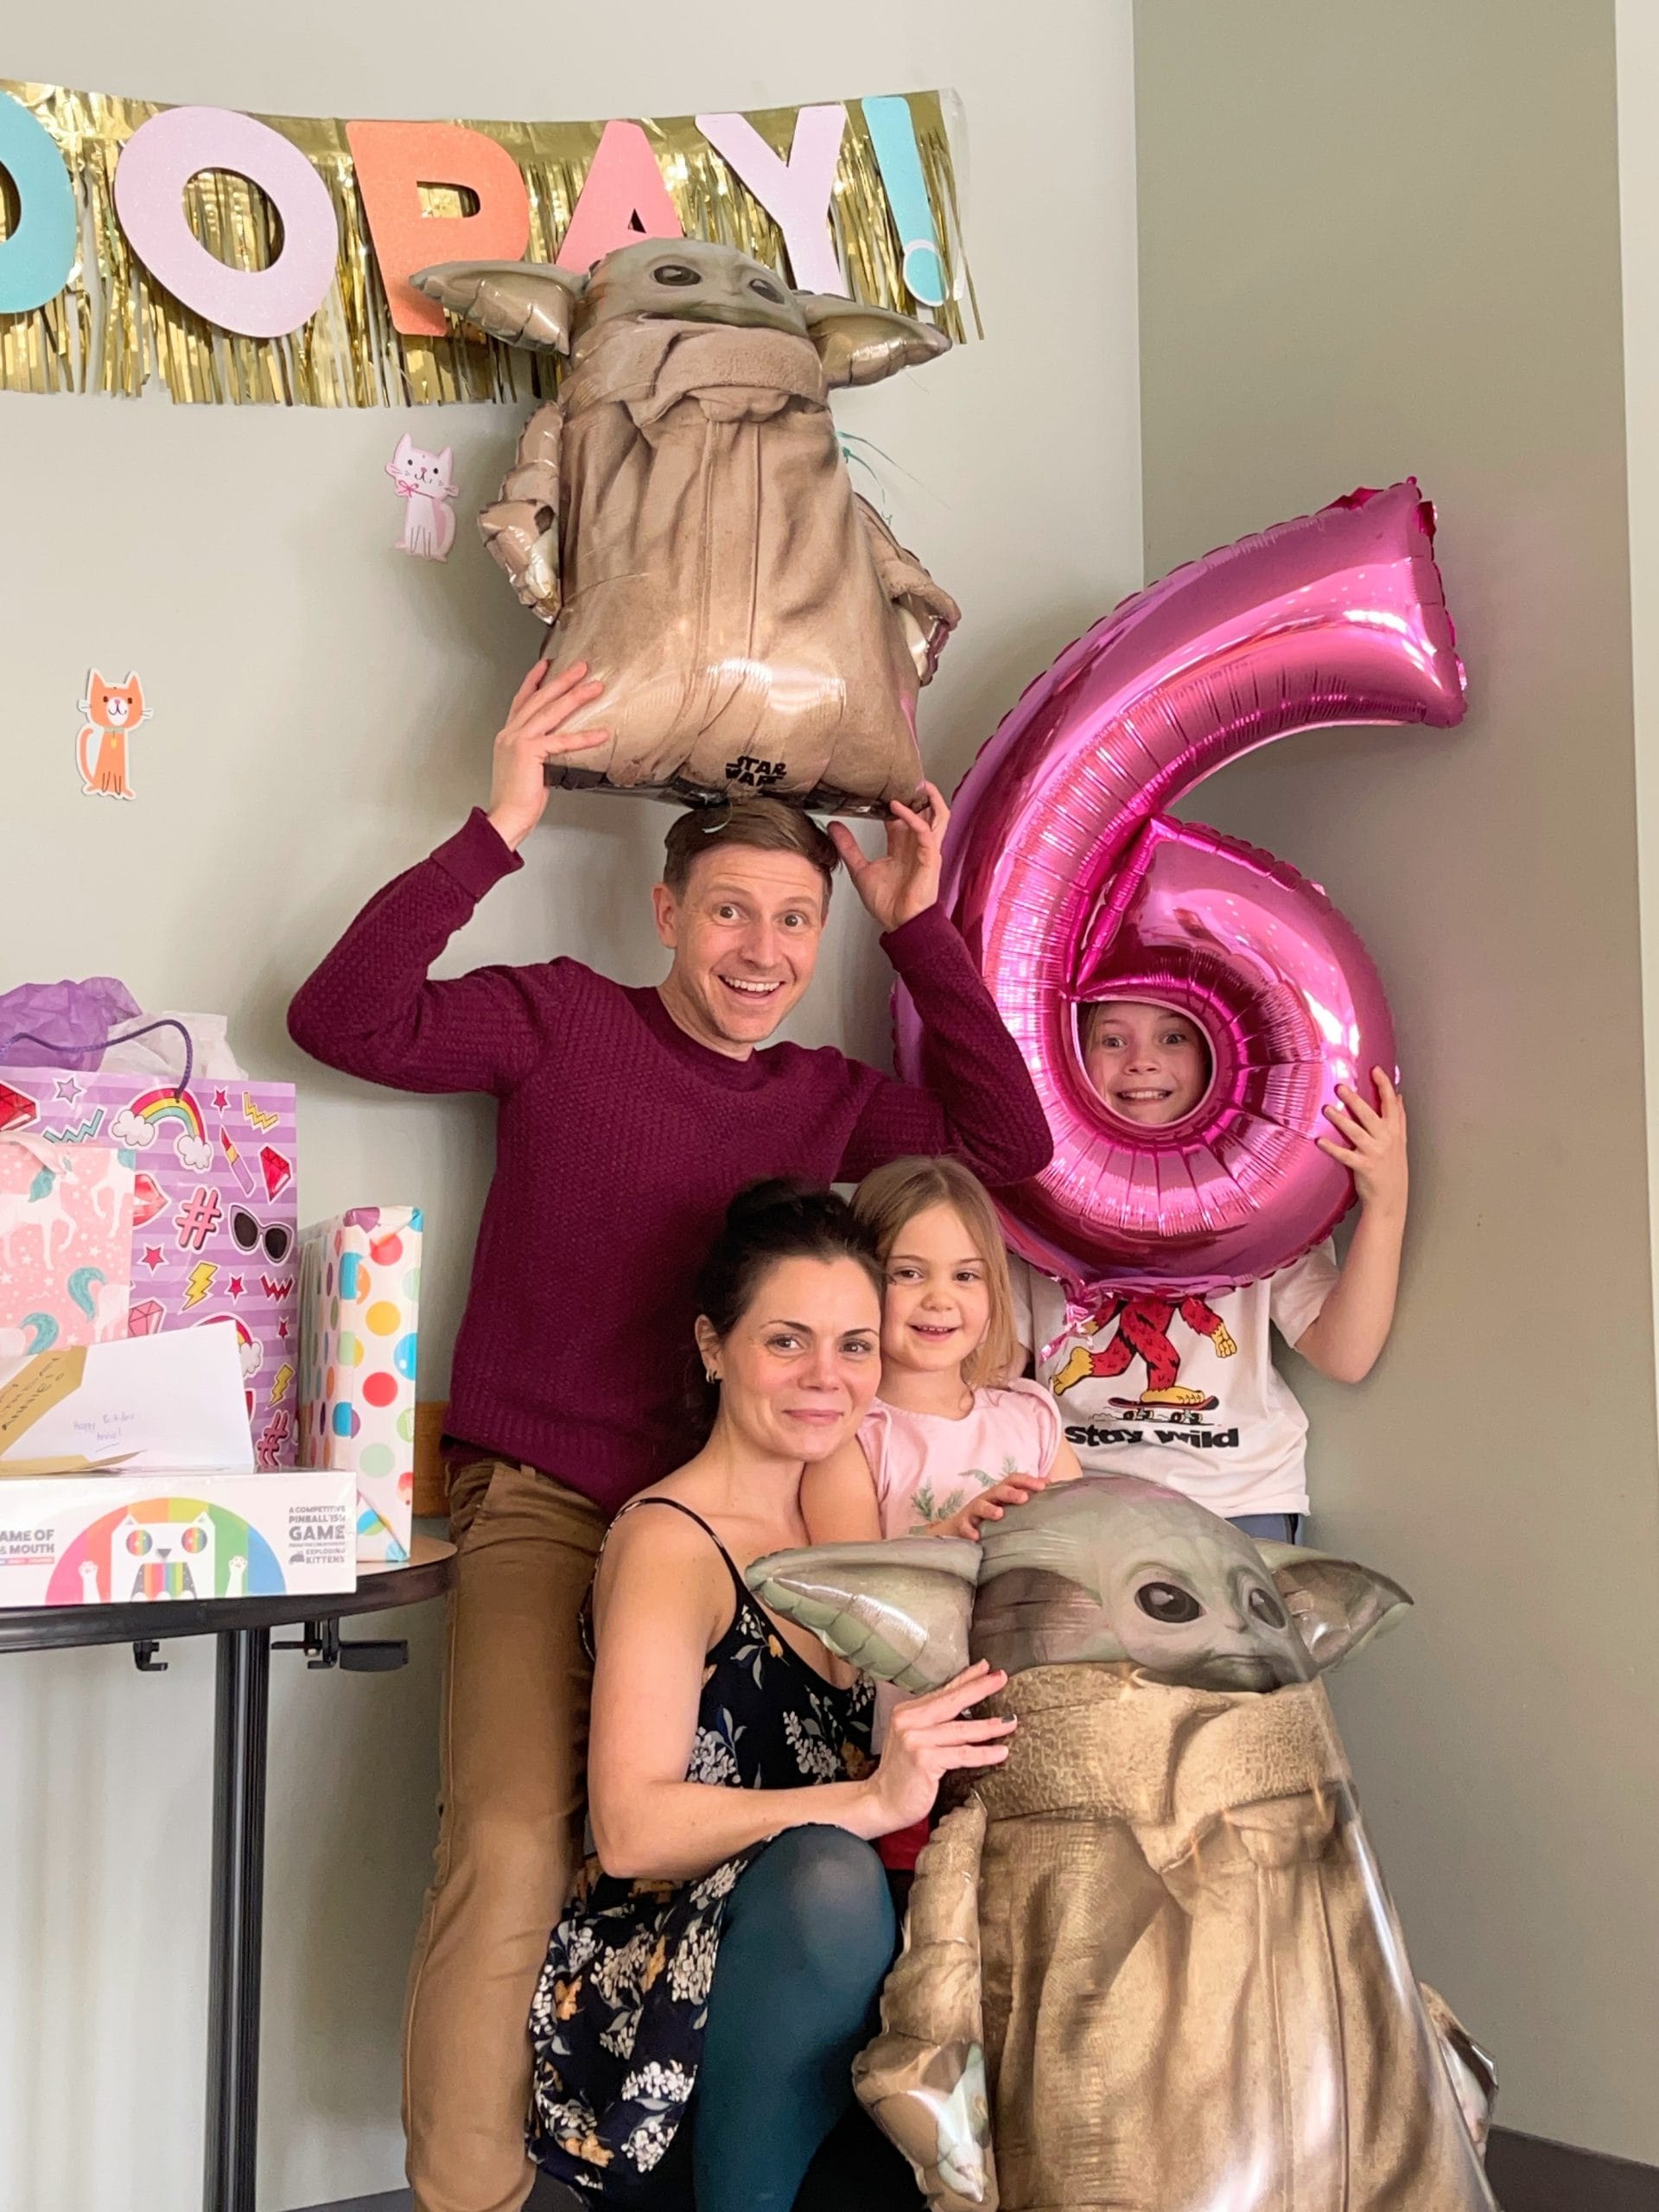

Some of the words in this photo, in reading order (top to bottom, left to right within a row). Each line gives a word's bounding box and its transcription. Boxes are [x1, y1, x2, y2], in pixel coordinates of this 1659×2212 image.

[726, 755, 787, 776] STAR
[893, 478, 1469, 1293] 6
[1065, 1425, 1144, 1446] stay
[1154, 1428, 1239, 1448] wild
[0, 1530, 32, 1541] AME
[35, 1529, 54, 1541] OF
[289, 1525, 345, 1541] GAME
[10, 1543, 54, 1554] MOUTH
